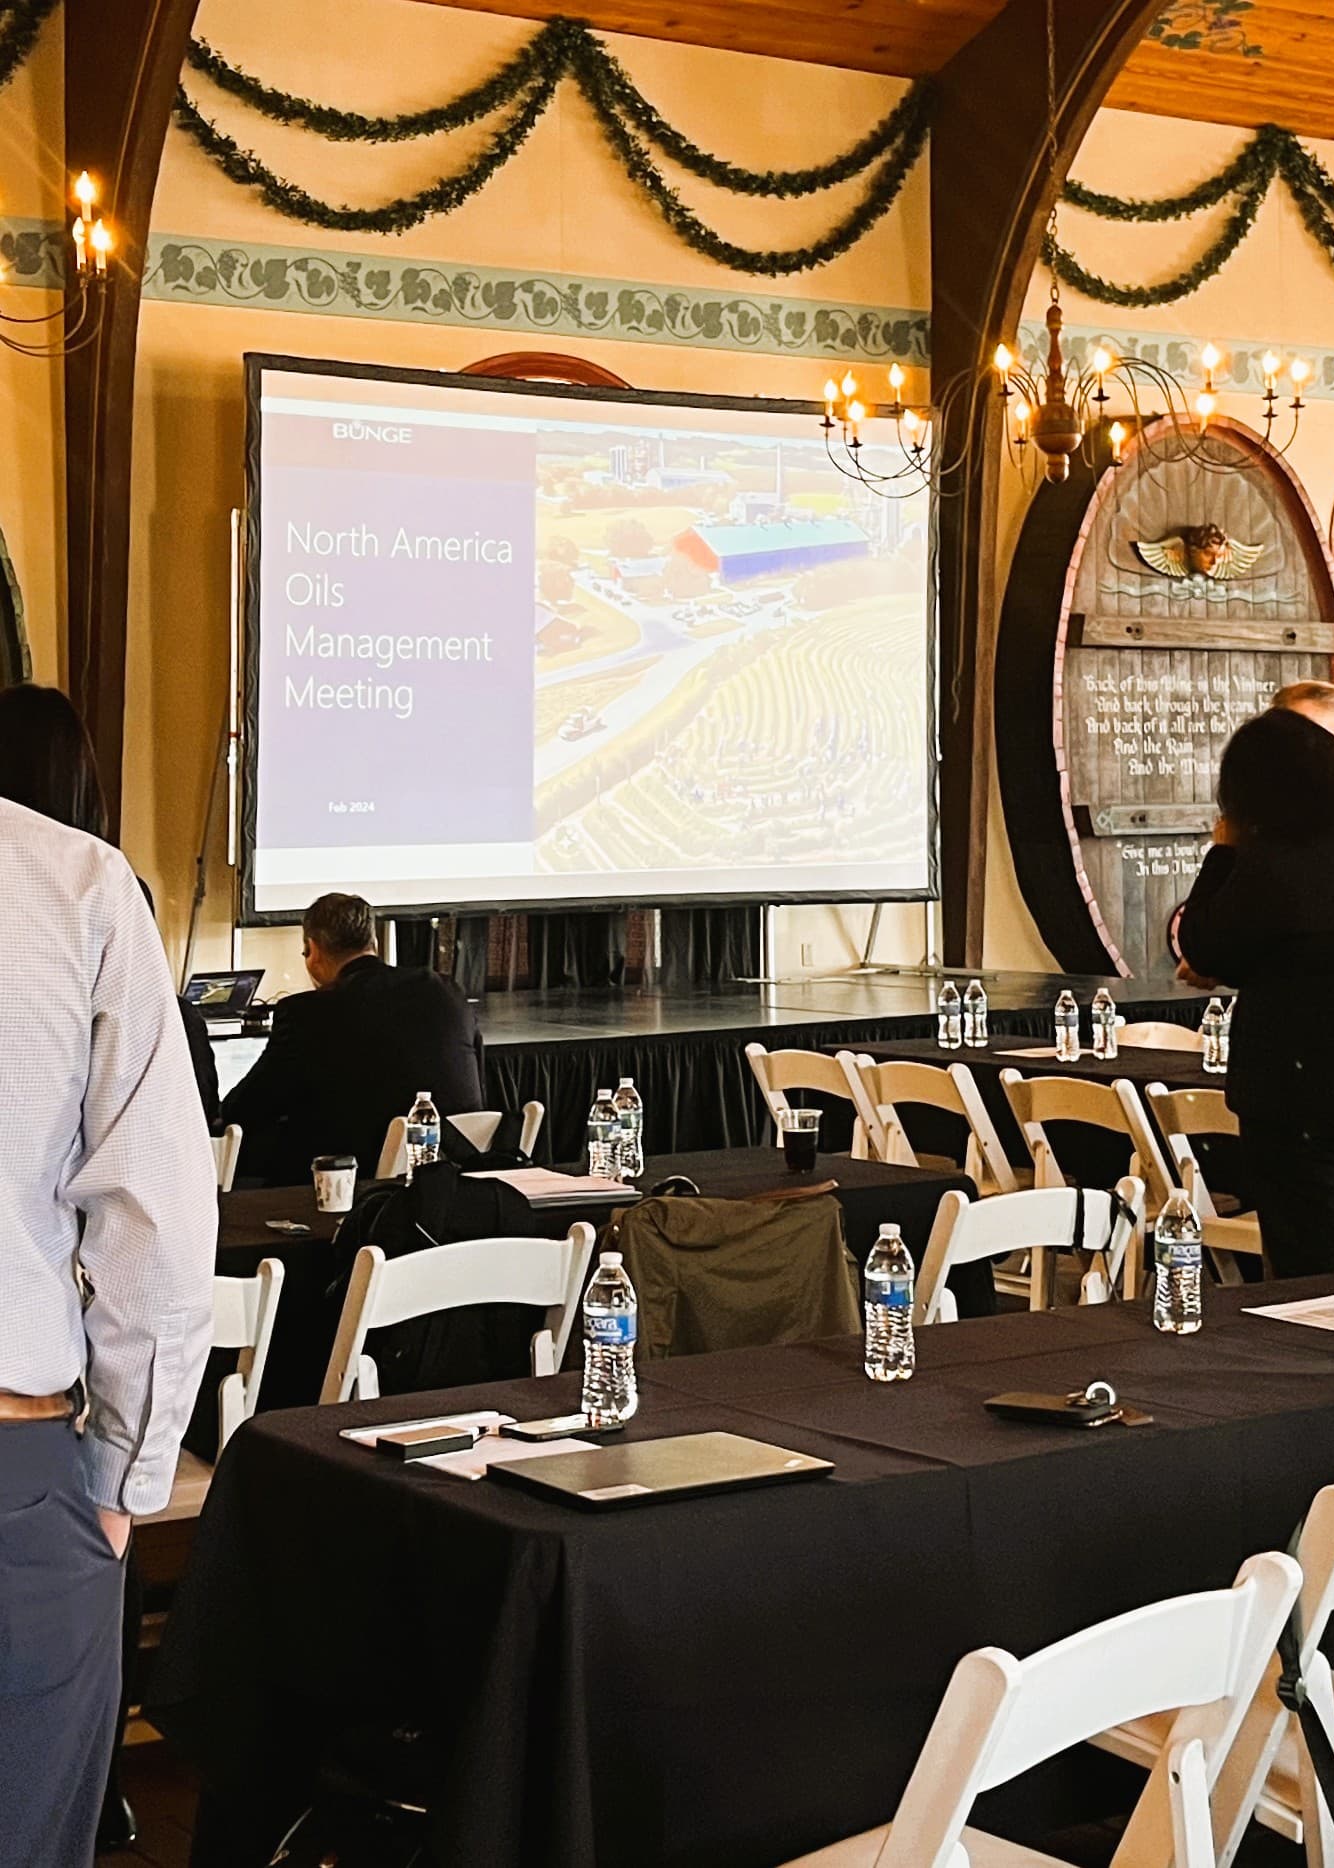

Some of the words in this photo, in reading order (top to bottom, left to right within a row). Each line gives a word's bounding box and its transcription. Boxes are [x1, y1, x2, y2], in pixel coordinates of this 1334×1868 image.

[332, 420, 413, 444] BUNGE
[287, 521, 379, 558] North
[391, 527, 513, 564] America
[286, 572, 345, 607] Oils
[286, 623, 493, 669] Management
[1083, 673, 1118, 694] Back
[1120, 675, 1135, 693] of
[1213, 674, 1231, 693] the
[285, 675, 414, 719] Meeting
[1095, 696, 1120, 713] And
[1124, 695, 1153, 715] back
[1155, 694, 1199, 717] through
[1203, 695, 1221, 713] the
[1085, 716, 1110, 734] And
[1113, 715, 1142, 735] back
[1143, 717, 1158, 734] of
[1171, 716, 1185, 734] all
[1210, 715, 1226, 734] the
[1114, 738, 1138, 755] And
[1143, 736, 1162, 754] the
[1128, 758, 1153, 776] And
[1158, 756, 1176, 777] the
[328, 801, 347, 814] Feb
[349, 801, 375, 814] 2024
[1165, 846, 1173, 857] a
[1135, 861, 1150, 876] In
